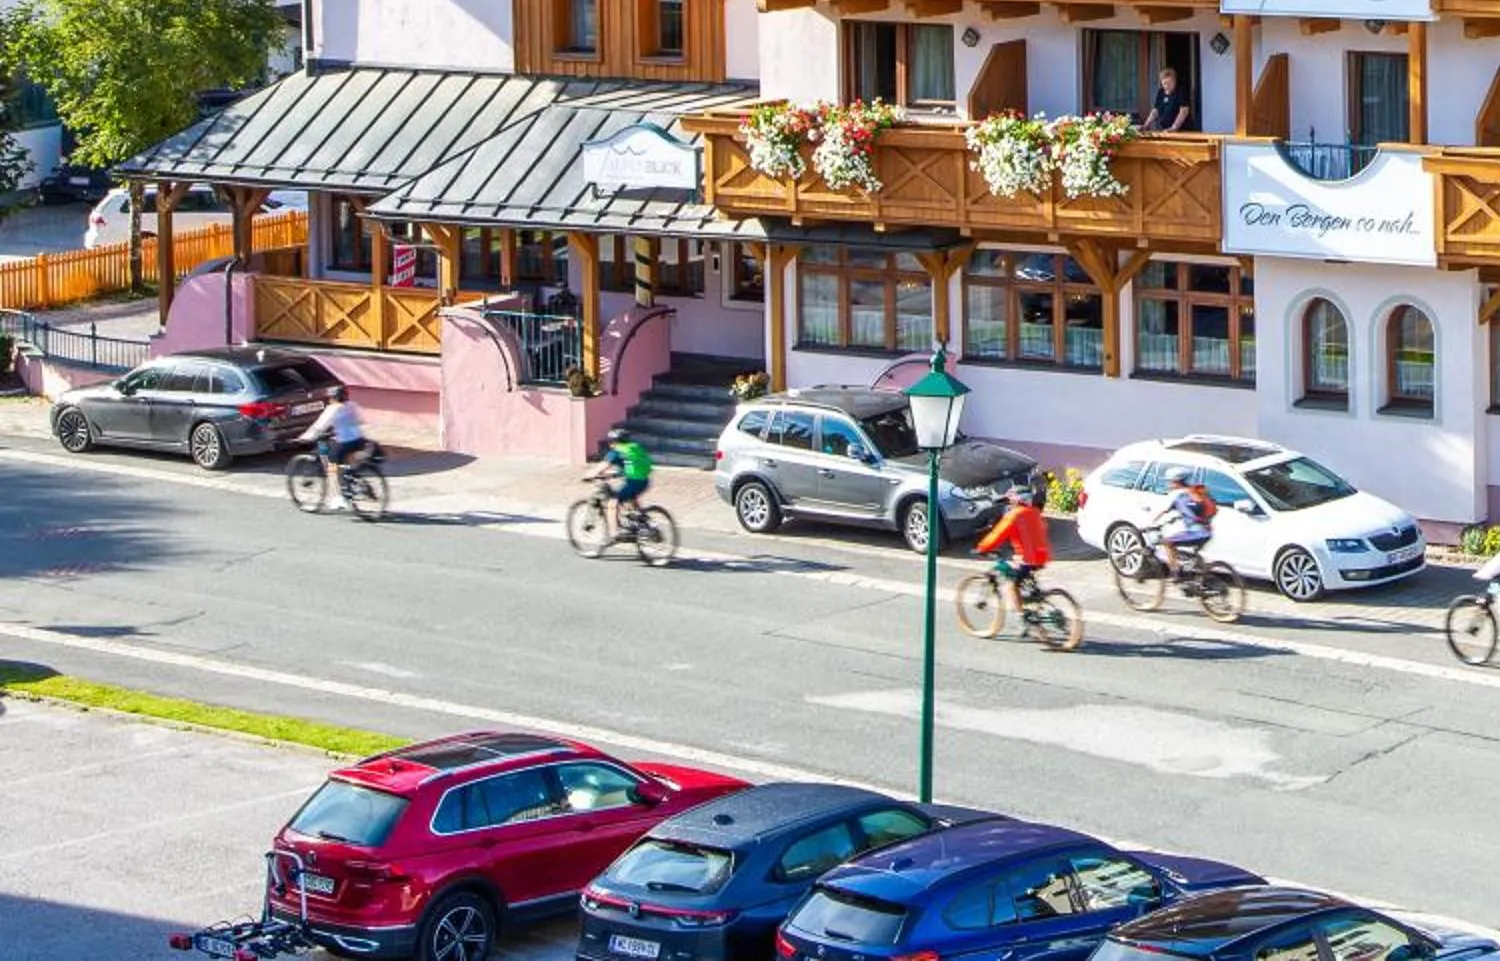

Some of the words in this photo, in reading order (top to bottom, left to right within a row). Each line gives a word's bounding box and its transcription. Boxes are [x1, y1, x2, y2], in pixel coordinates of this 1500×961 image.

[1240, 202, 1281, 226] Den
[1286, 204, 1352, 238] Bergen
[1355, 217, 1374, 232] so
